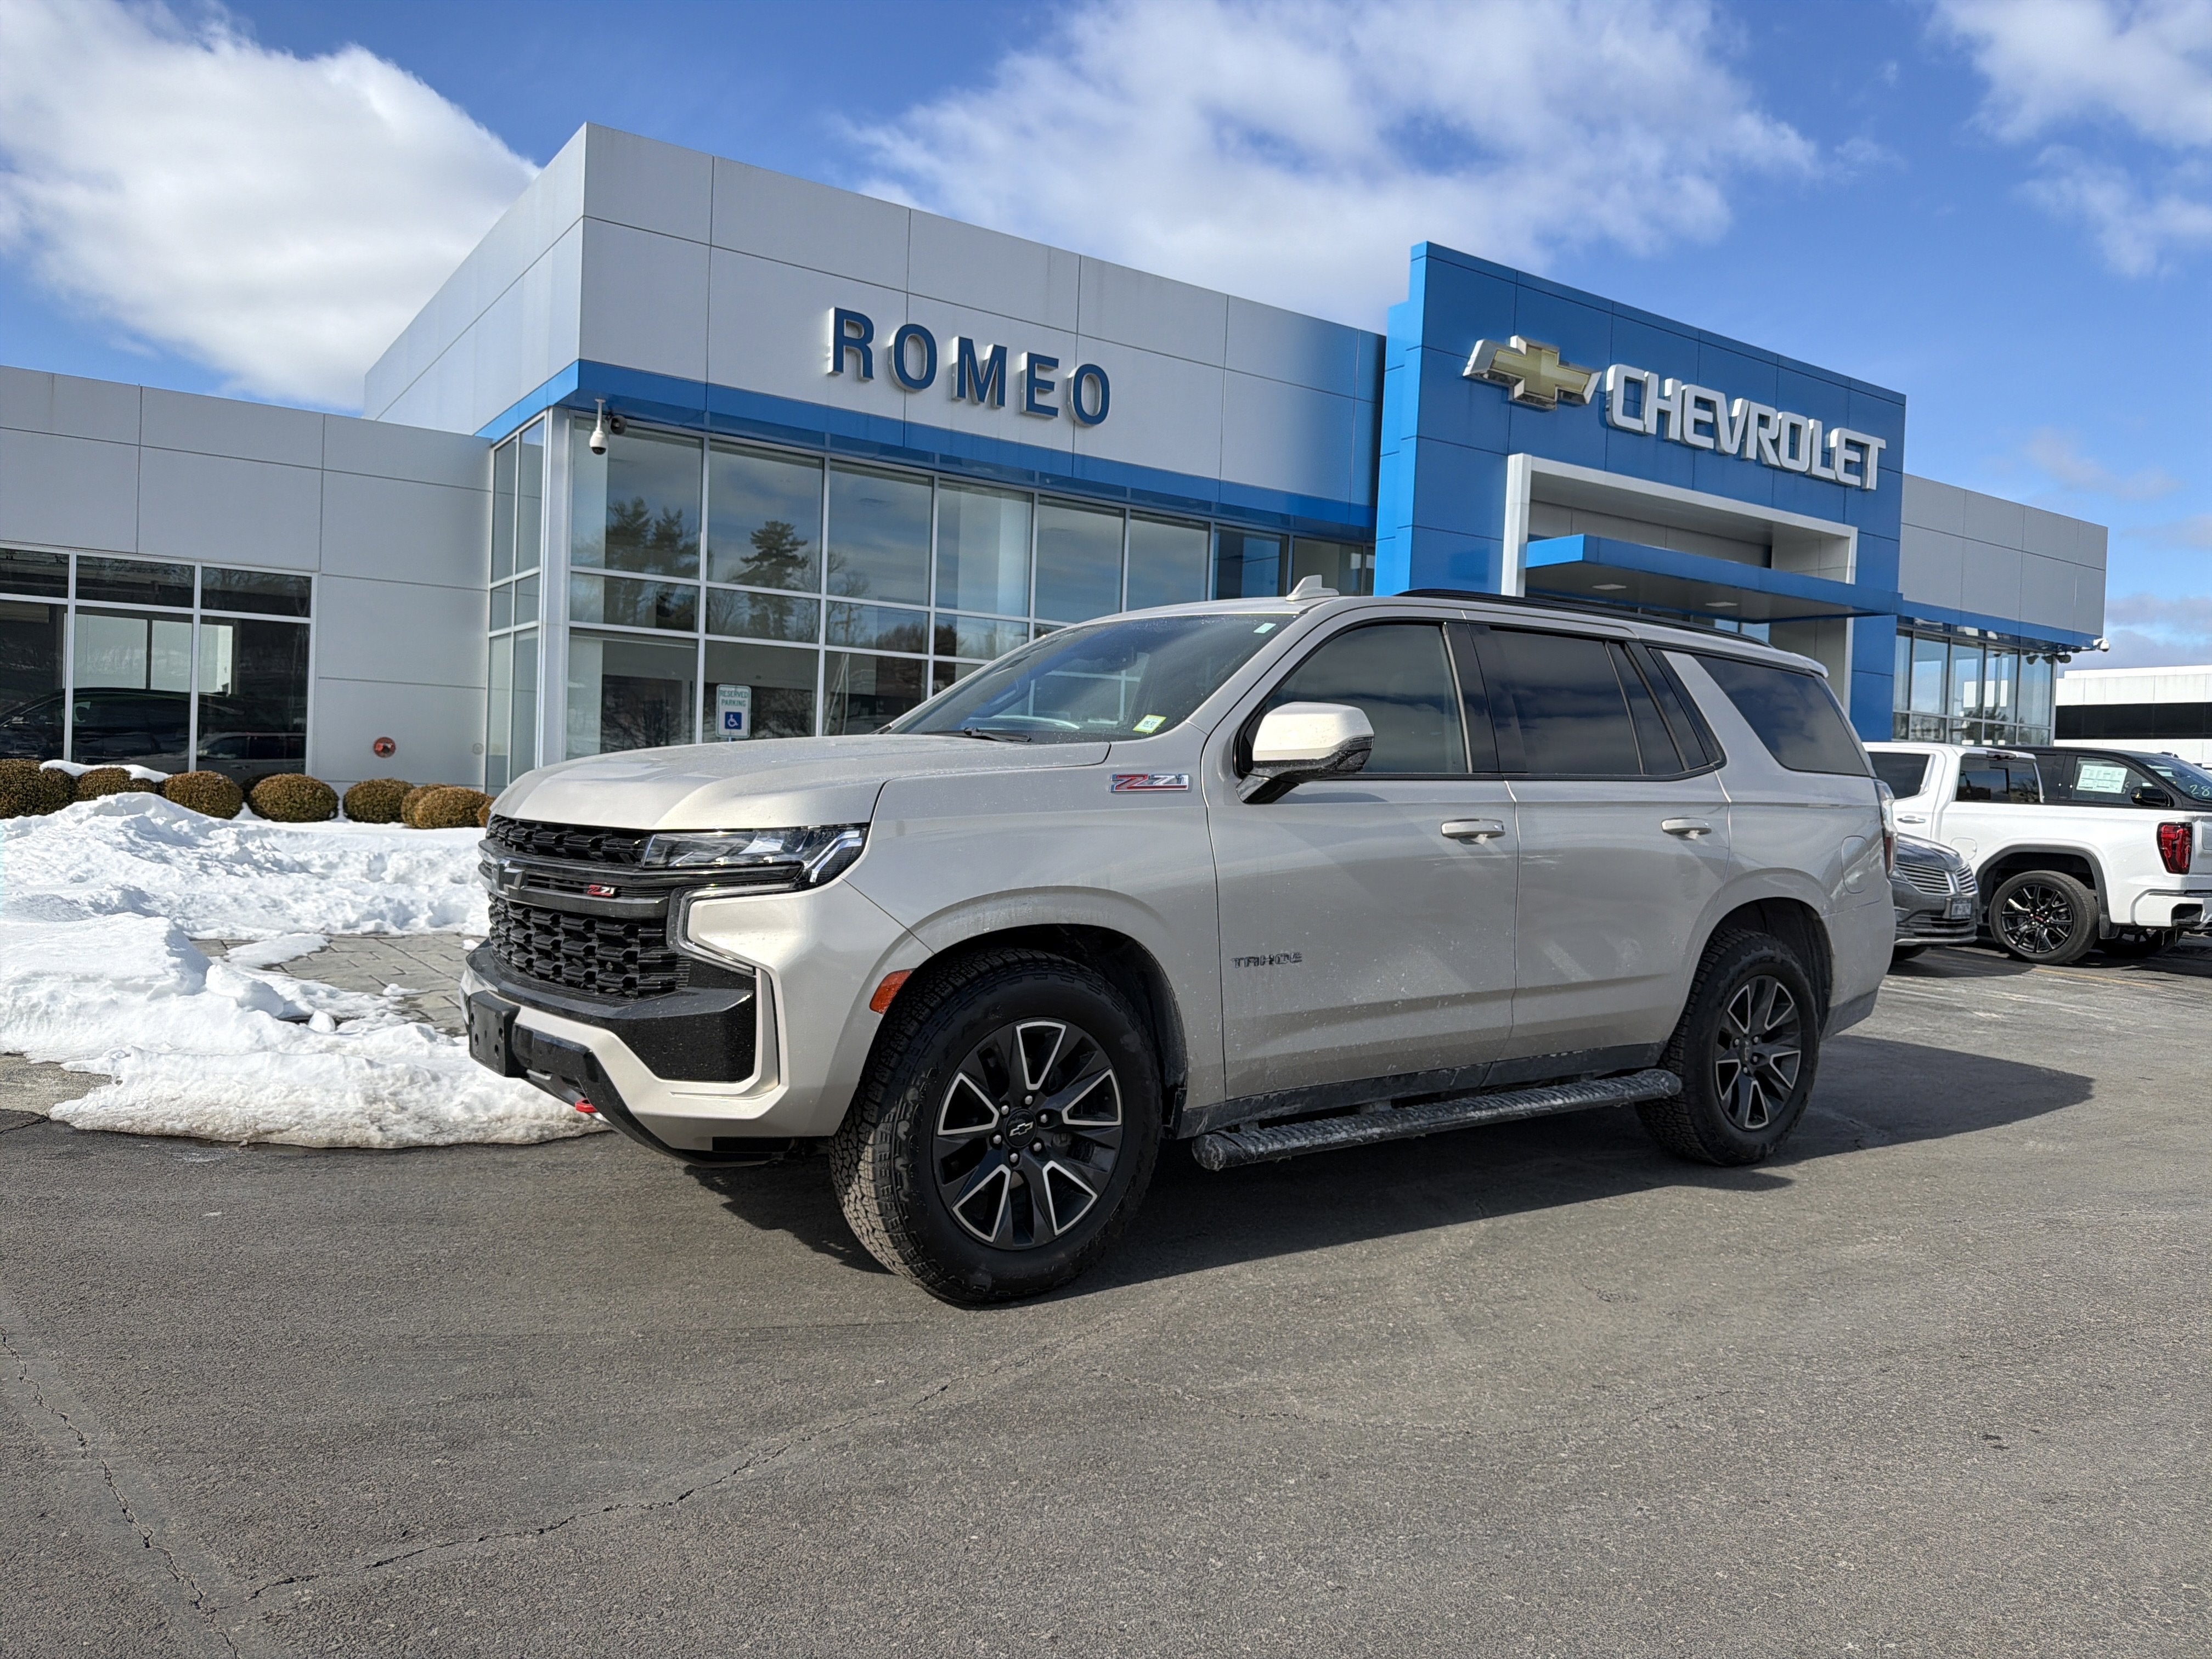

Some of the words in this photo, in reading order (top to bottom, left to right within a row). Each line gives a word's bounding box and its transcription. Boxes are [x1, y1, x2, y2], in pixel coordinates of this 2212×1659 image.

[828, 307, 1110, 427] ROMEO
[1606, 364, 1886, 490] CHEVROLET
[719, 690, 748, 698] RESERVED
[721, 699, 747, 707] PARKING
[2190, 785, 2210, 797] 28
[588, 884, 616, 896] Z71
[1230, 952, 1302, 968] TAHOE
